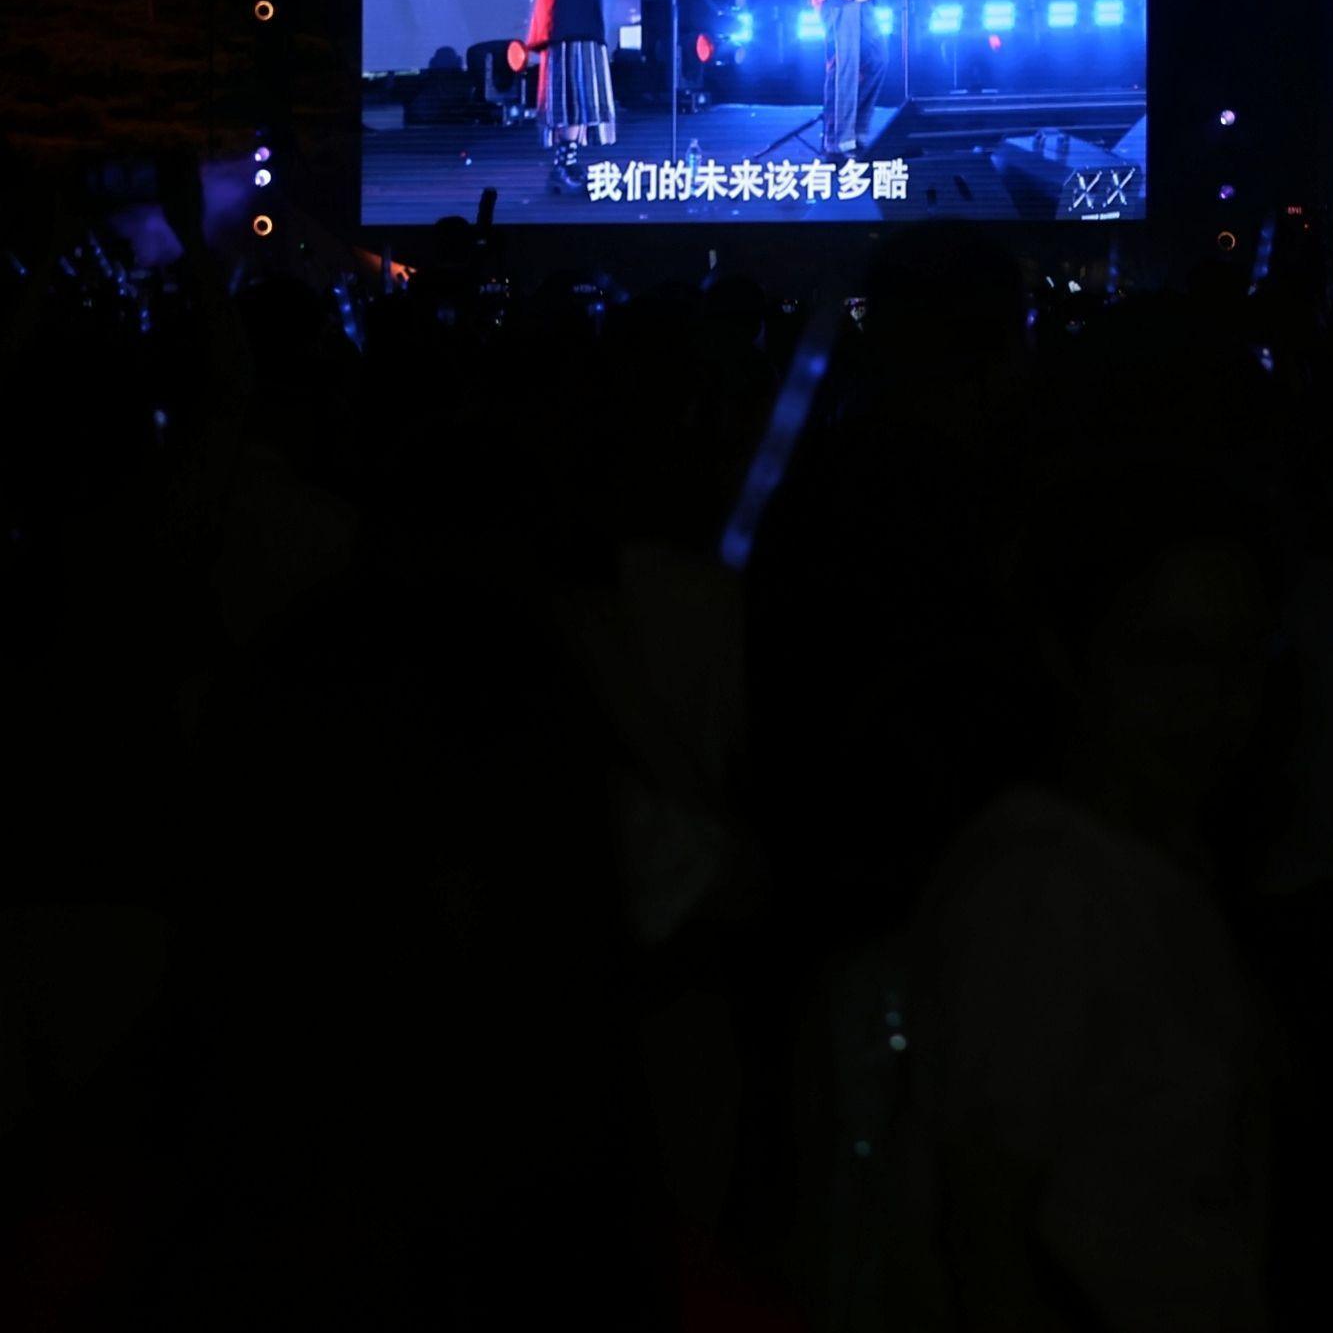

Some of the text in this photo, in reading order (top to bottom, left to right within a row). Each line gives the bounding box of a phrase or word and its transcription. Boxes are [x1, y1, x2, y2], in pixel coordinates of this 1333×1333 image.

[587, 158, 910, 201] 我们的未来该有多酷
